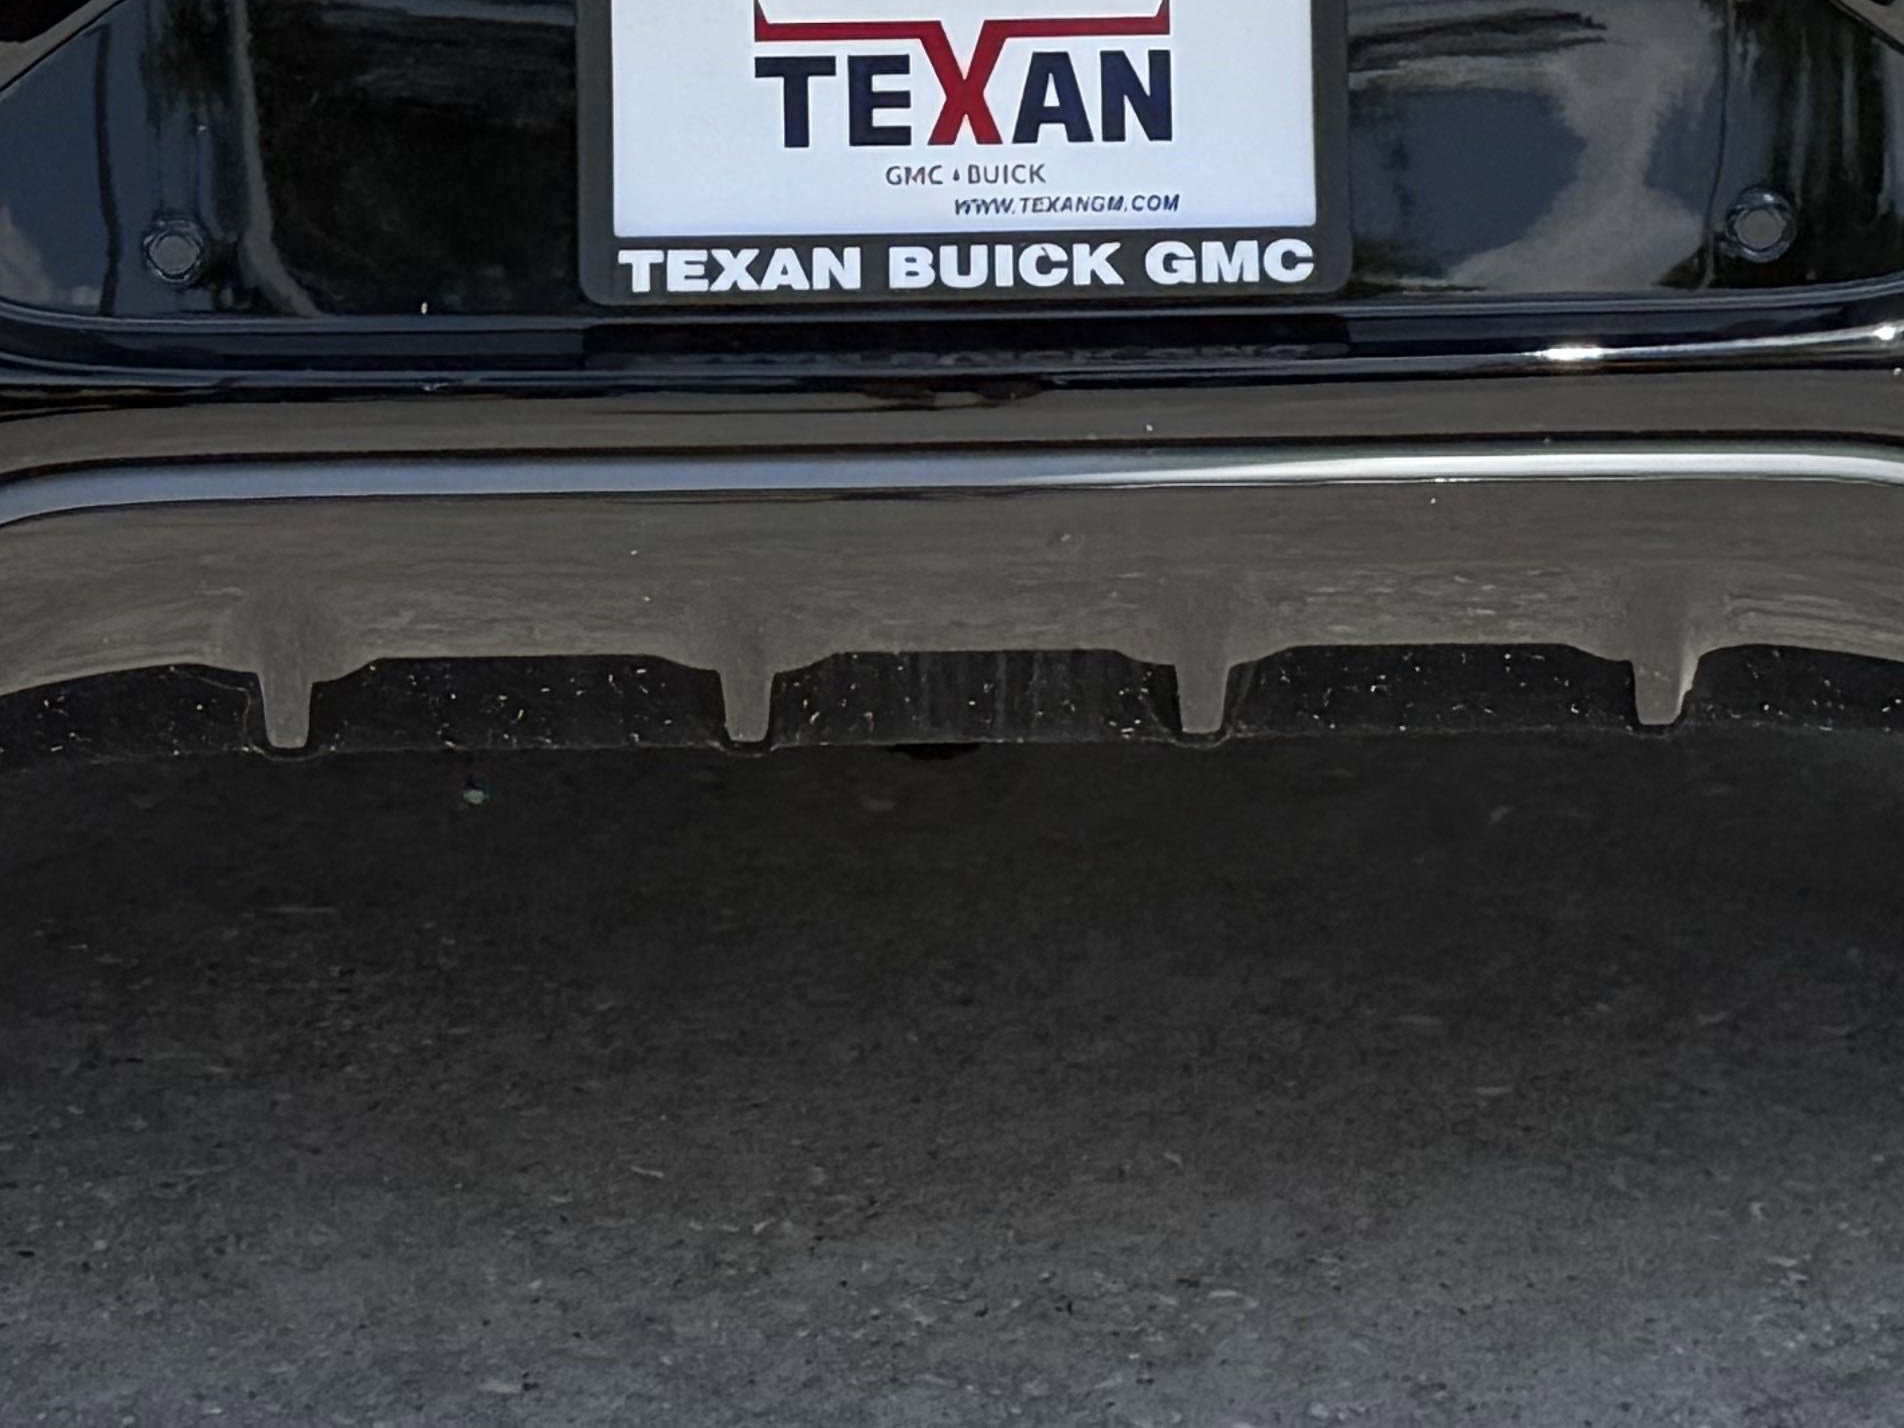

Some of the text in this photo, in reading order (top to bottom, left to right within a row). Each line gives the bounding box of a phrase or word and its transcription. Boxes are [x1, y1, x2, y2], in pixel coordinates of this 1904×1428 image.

[753, 20, 1173, 148] TEXAN
[886, 162, 1047, 186] GMC BUICK
[953, 192, 1181, 216] WWW.TEXANGM.COM
[617, 237, 1315, 294] TEXAN BUICK GMC
